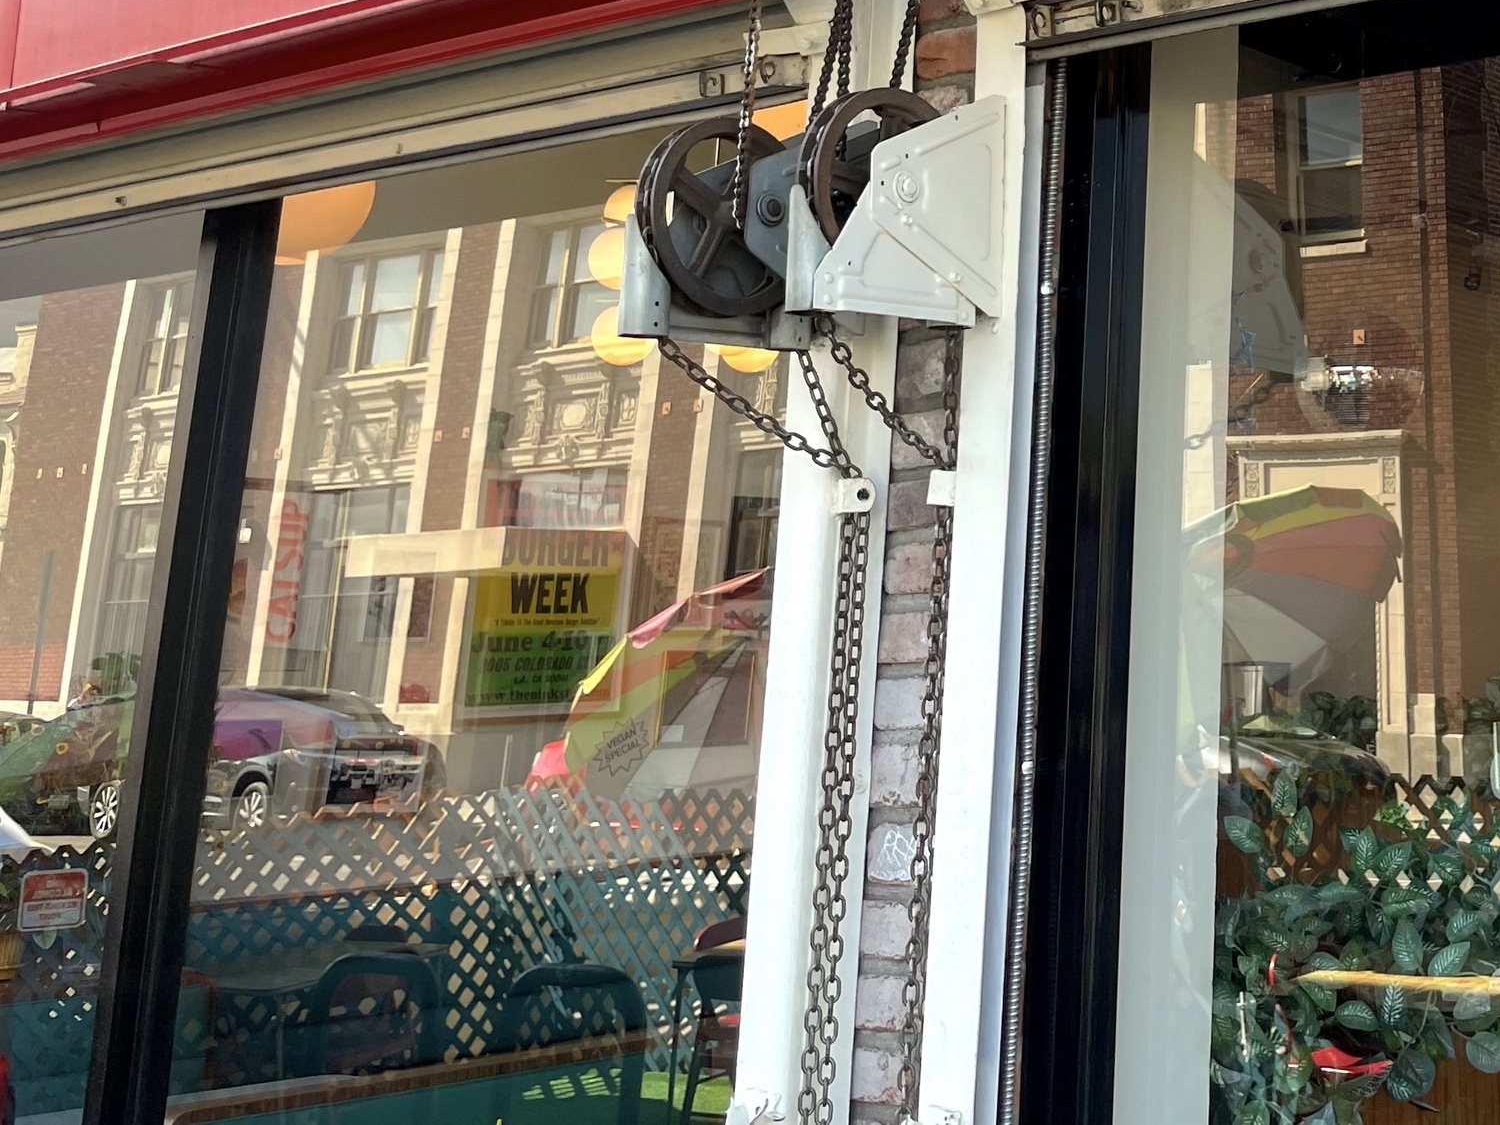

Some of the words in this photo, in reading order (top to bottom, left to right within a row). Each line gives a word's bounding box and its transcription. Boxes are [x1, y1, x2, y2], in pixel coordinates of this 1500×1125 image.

[501, 515, 609, 567] BURGER
[511, 572, 590, 614] WEEK
[471, 631, 534, 653] June
[607, 728, 636, 749] VEGAN
[605, 739, 641, 763] SPECIAL
